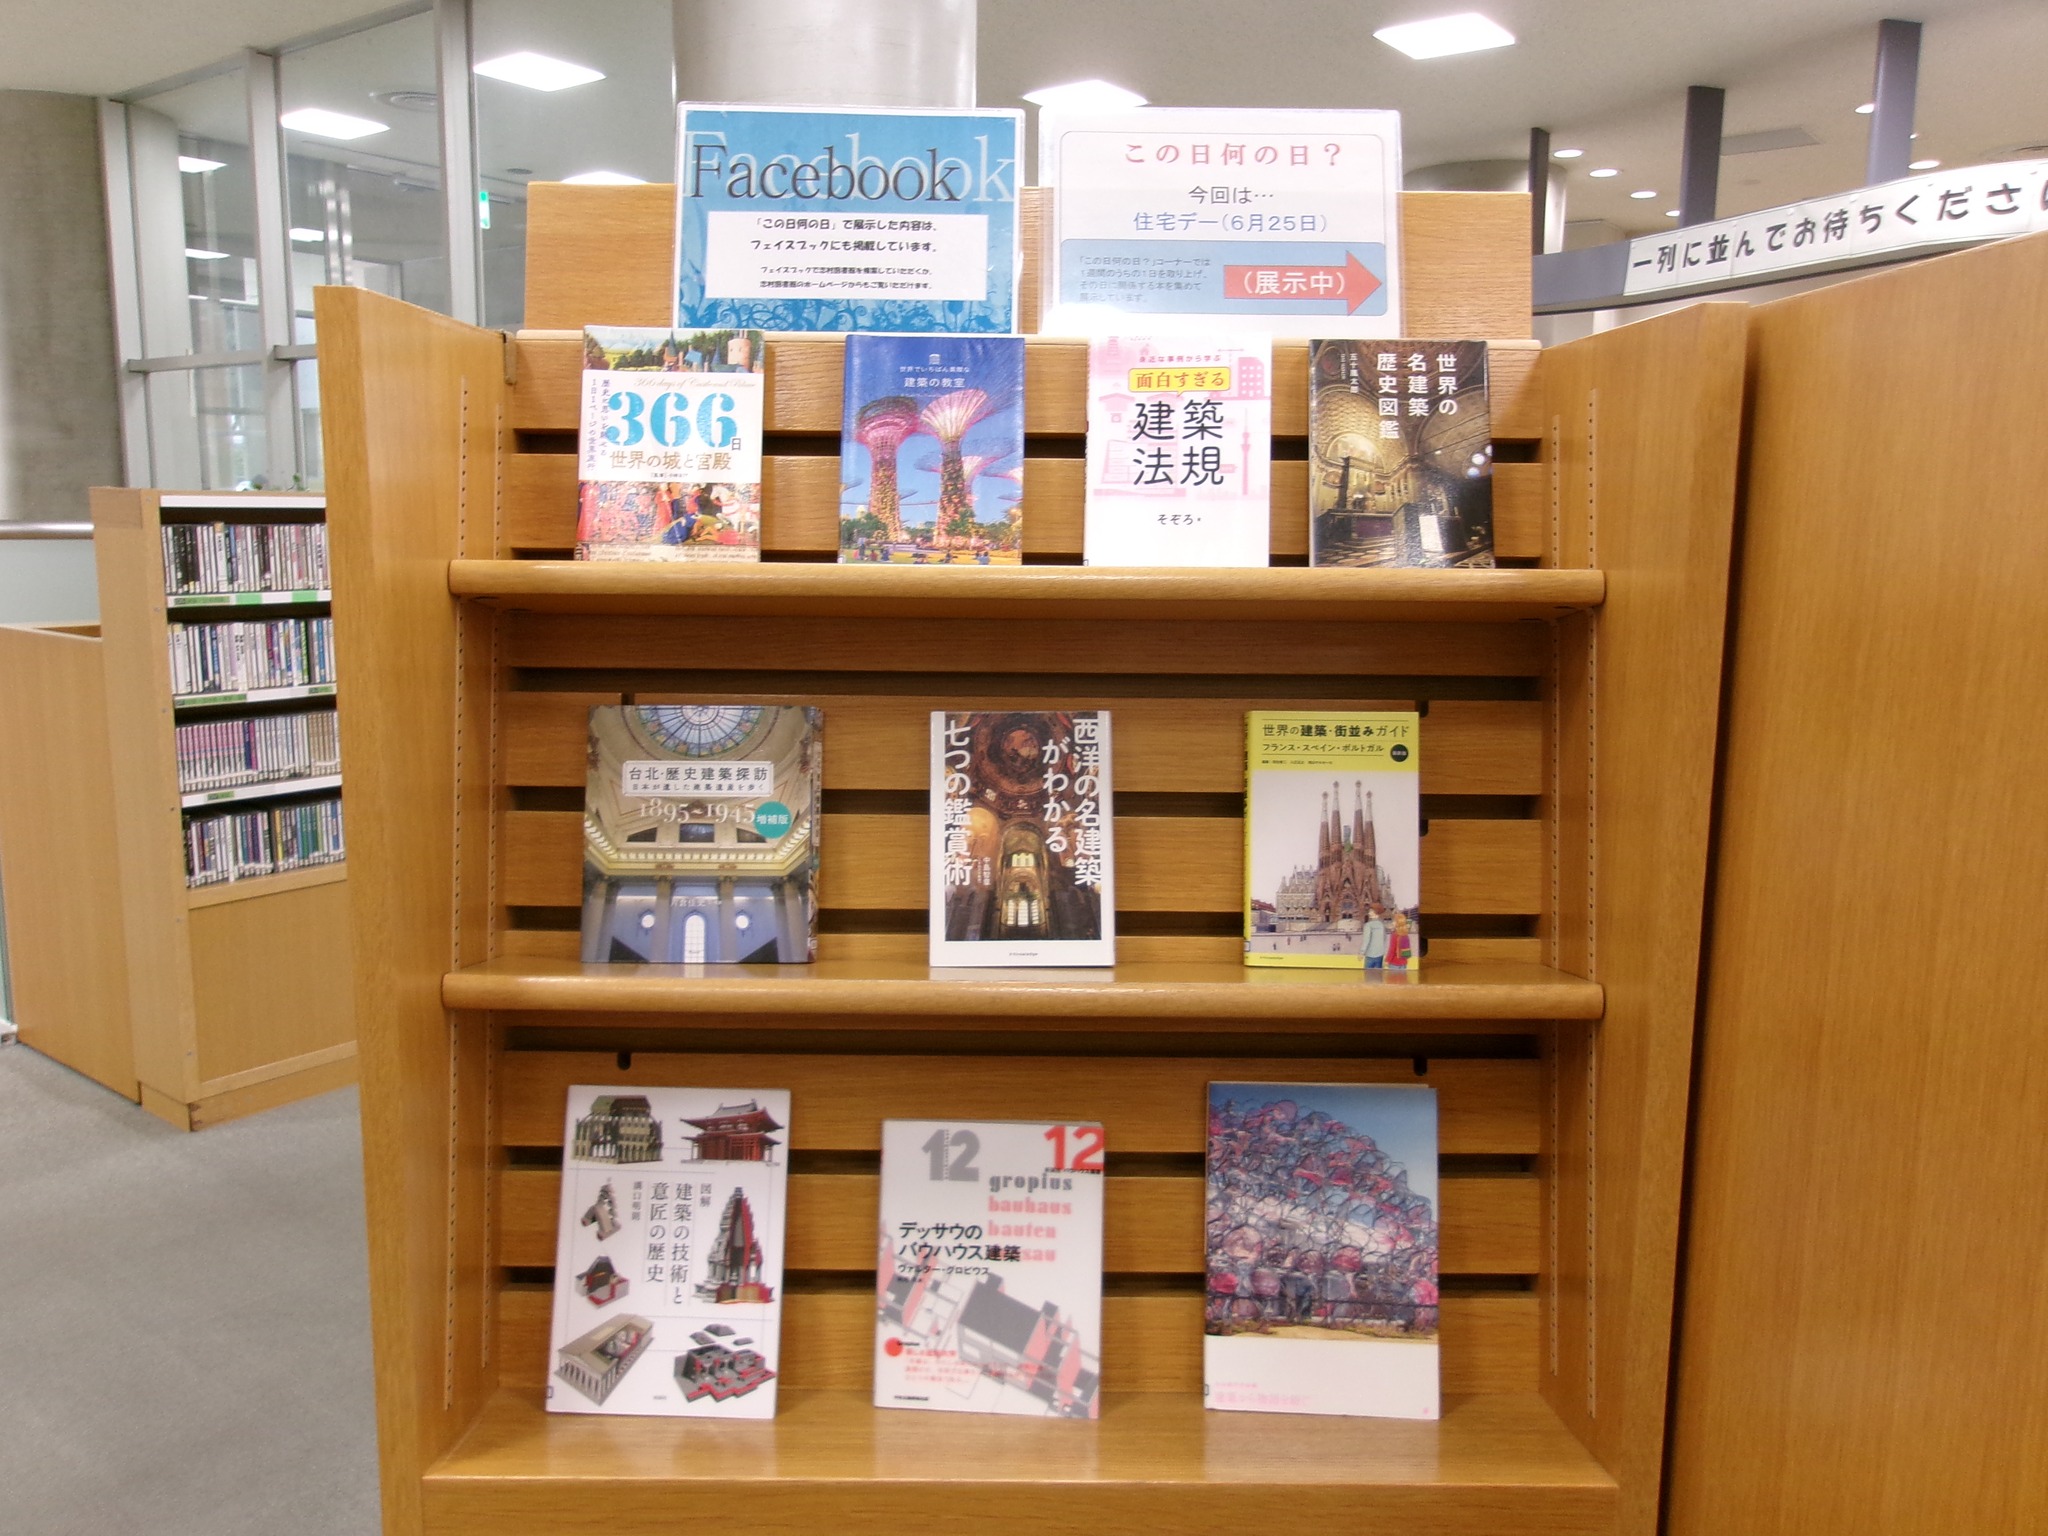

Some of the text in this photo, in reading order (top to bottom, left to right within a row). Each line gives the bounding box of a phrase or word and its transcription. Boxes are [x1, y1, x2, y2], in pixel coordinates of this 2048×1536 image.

[691, 143, 961, 202] Facebook
[1125, 143, 1341, 167] この日何の日？
[904, 377, 966, 388] 建築の教室
[1136, 371, 1225, 389] 面白すぎる
[1376, 353, 1400, 439] 歴史図鑑
[1407, 353, 1429, 417] 名建築
[1436, 353, 1458, 415] 世界の
[606, 390, 737, 448] 366
[1132, 399, 1225, 441] 建築
[609, 450, 732, 471] 世界の城と宮殿
[1133, 446, 1224, 487] 法規
[1263, 724, 1409, 737] 世界の建築・街並みガイド
[944, 719, 972, 886] 七つの鑑賞術
[1042, 736, 1071, 853] がわかる
[1072, 718, 1102, 886] 西洋の名建築
[756, 815, 789, 825] 増補版
[921, 1129, 981, 1182] 12
[1043, 1125, 1105, 1171] 12
[989, 1172, 1073, 1192] gropius
[987, 1195, 1072, 1215] bauhaus
[646, 1182, 669, 1283] 意匠の歴史
[671, 1183, 693, 1304] 建築の技術と
[899, 1221, 983, 1240] デッサウの
[899, 1242, 1021, 1262] バウハウス建築
